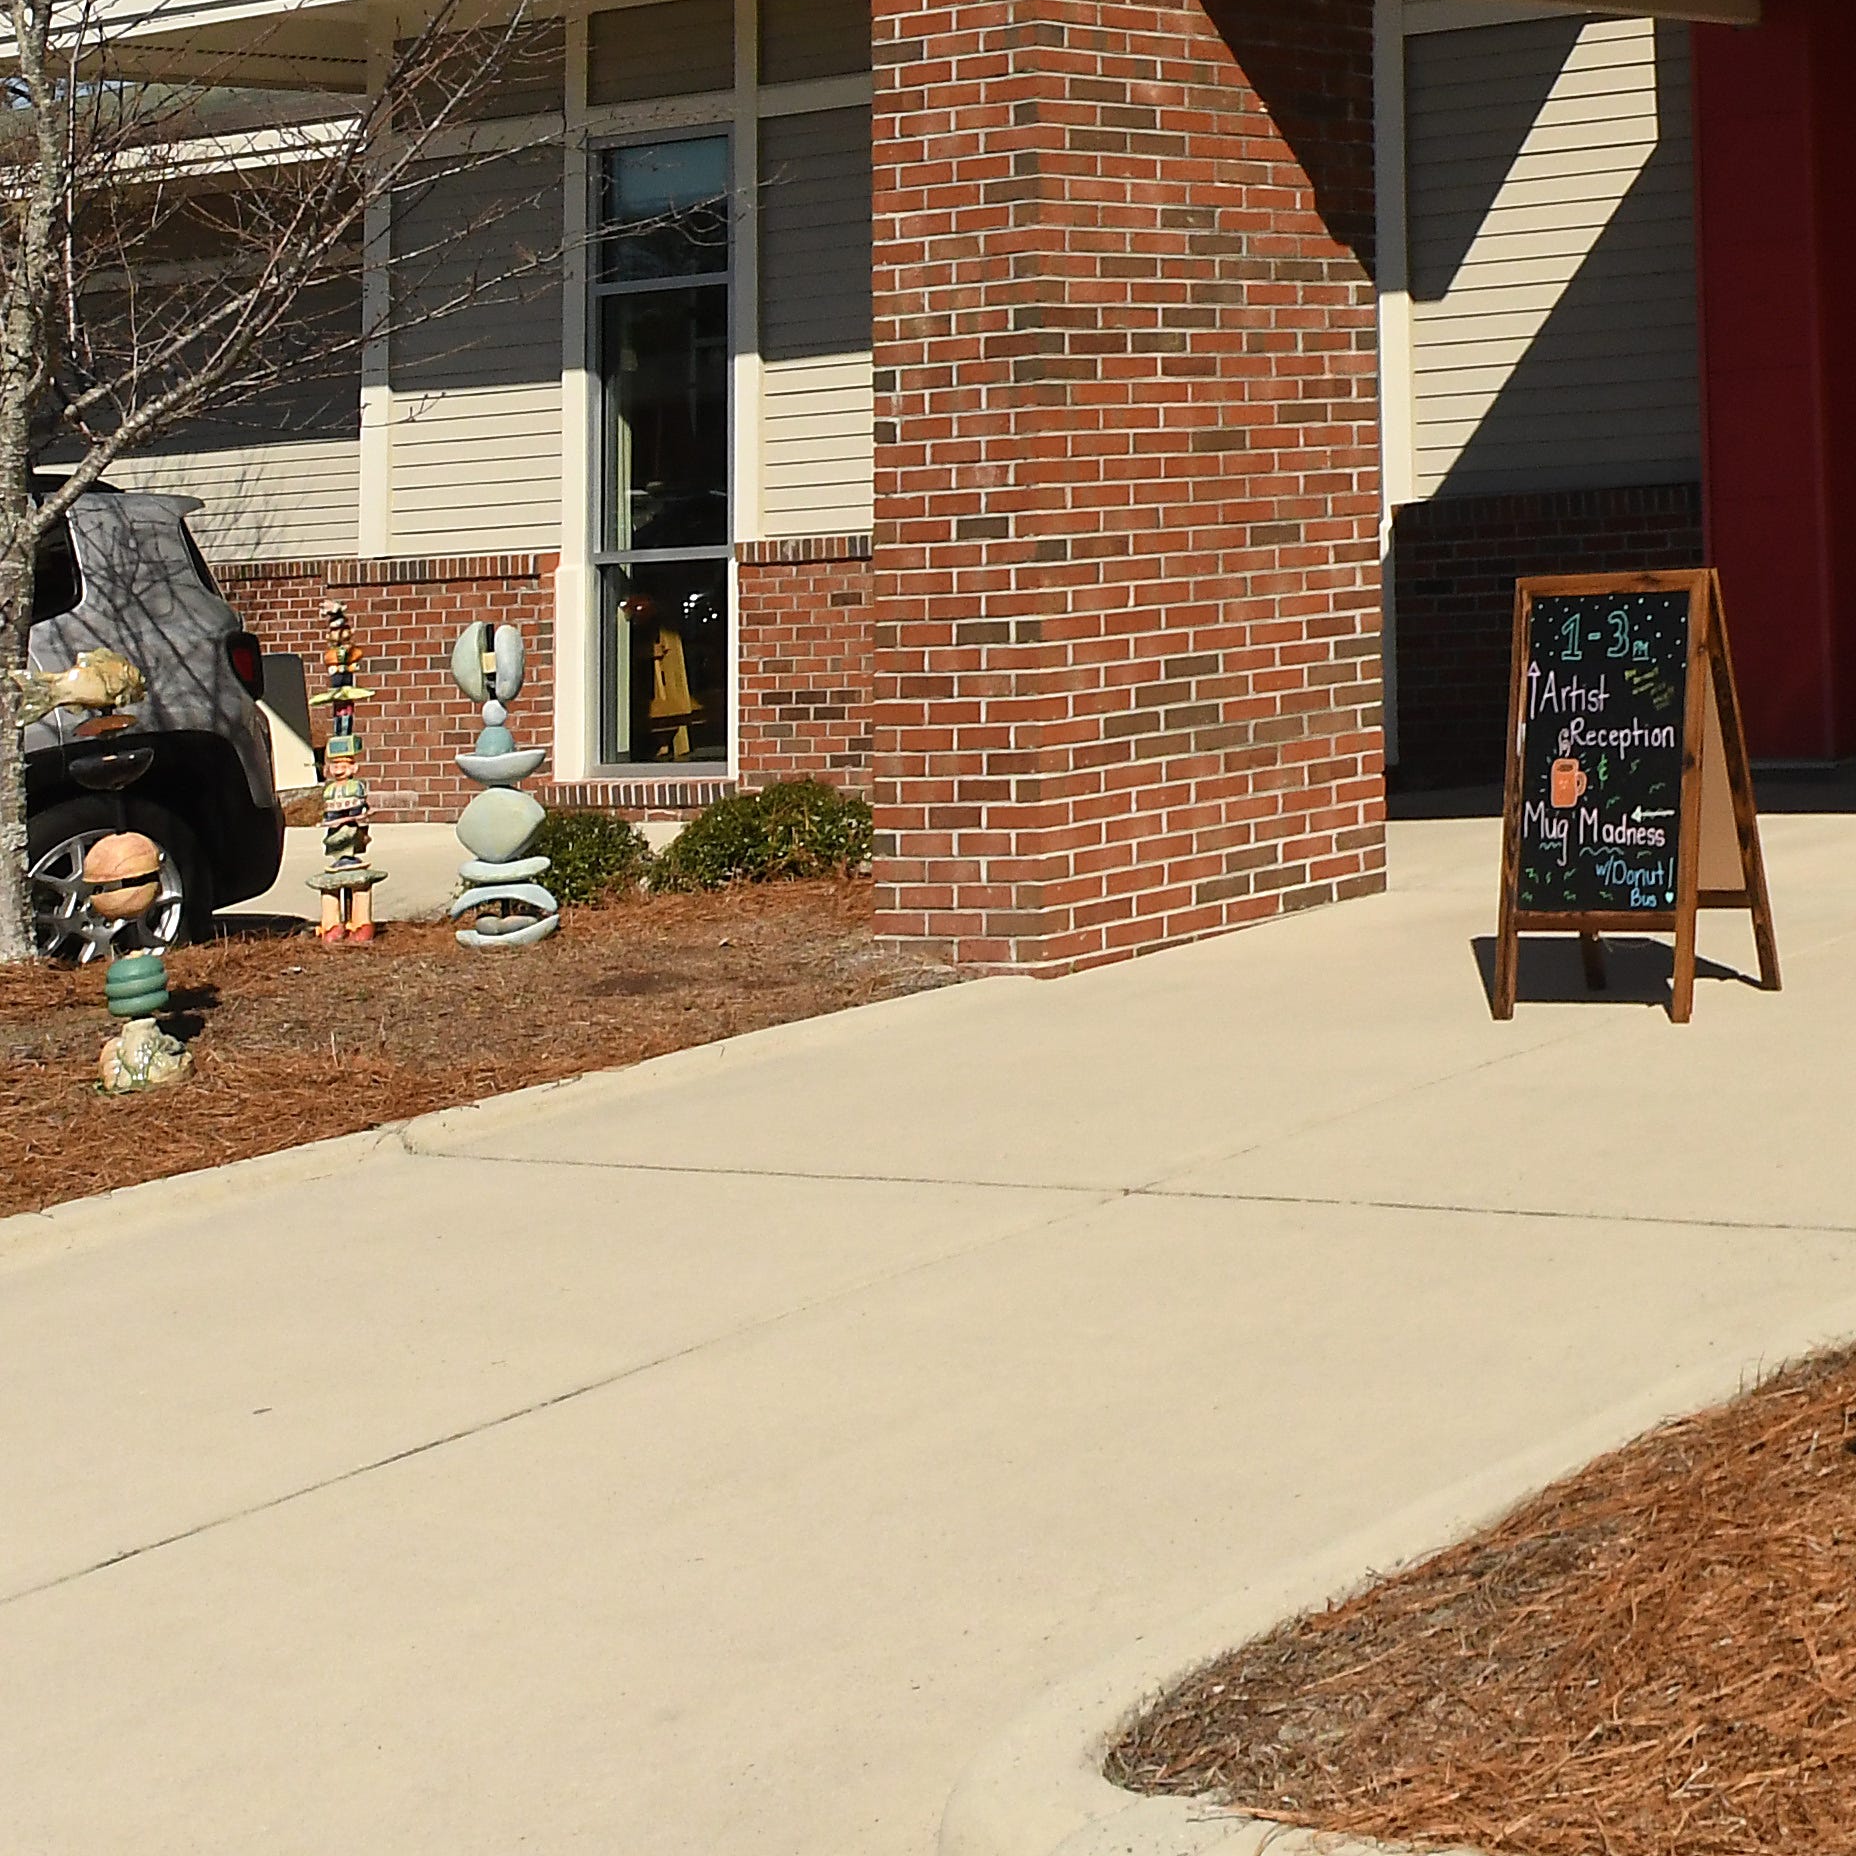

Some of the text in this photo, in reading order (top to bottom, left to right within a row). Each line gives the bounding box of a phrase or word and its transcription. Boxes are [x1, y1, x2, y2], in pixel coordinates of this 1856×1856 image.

[1539, 670, 1610, 713] Artist
[1570, 716, 1675, 760] Reception
[1523, 800, 1666, 867] Mug Madness
[1630, 888, 1657, 908] Bus
